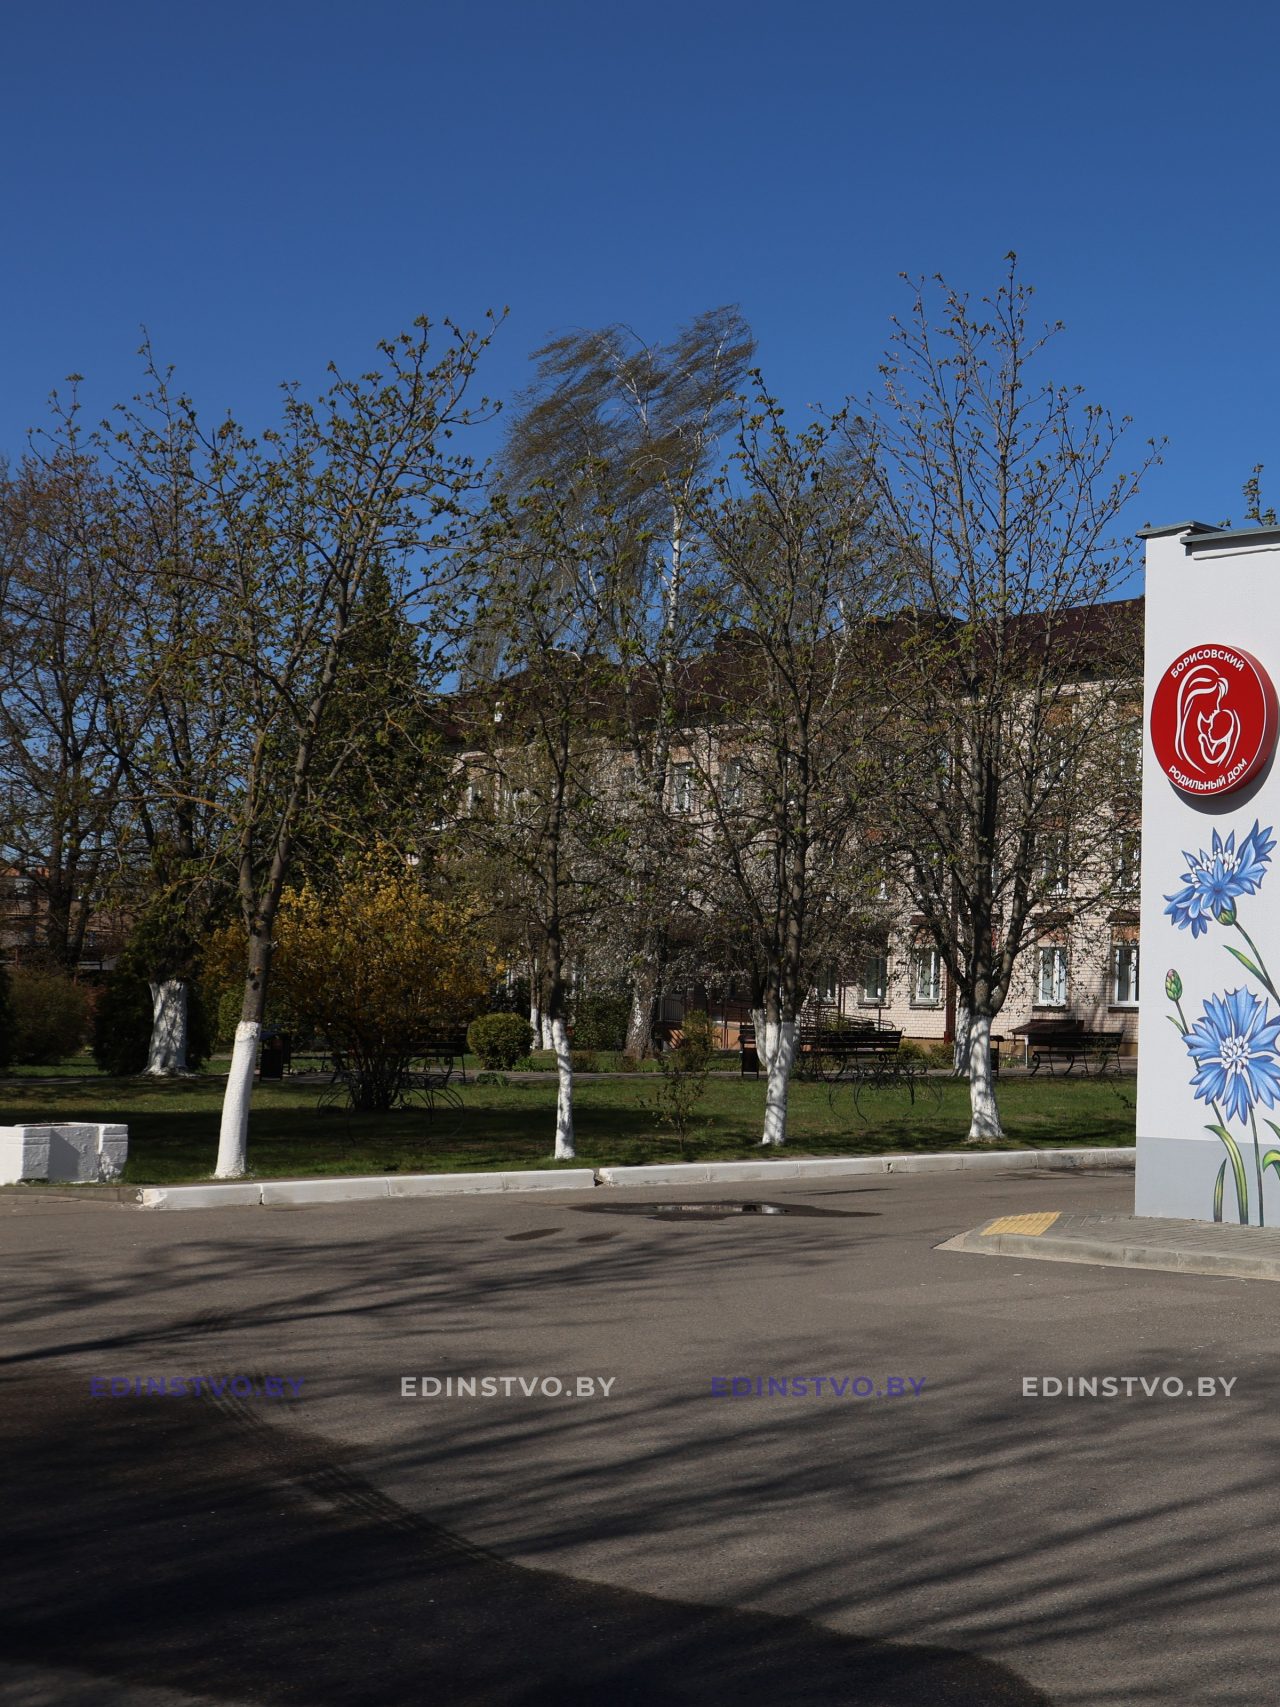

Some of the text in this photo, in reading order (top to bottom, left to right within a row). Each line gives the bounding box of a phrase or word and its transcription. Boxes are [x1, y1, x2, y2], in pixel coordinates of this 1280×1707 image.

[1170, 649, 1245, 679] БОРИСОВСКИЙ
[1168, 758, 1248, 791] РОДИЛЬНЫЙ ДОМ
